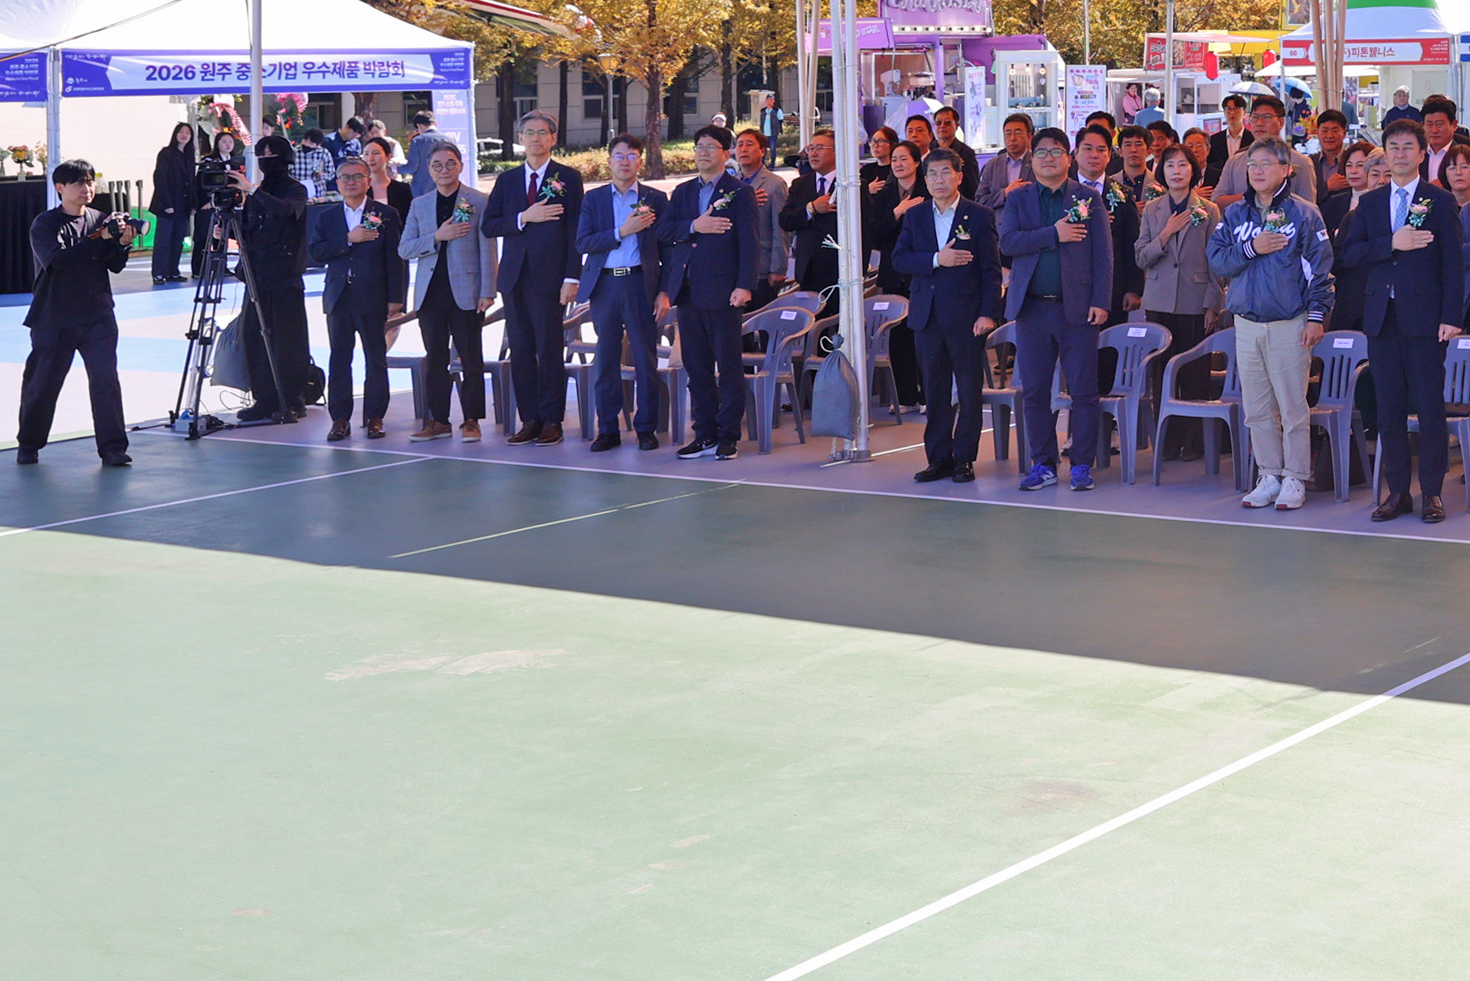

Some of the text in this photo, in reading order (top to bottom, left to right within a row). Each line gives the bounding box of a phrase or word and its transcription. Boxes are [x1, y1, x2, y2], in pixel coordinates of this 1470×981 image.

[145, 64, 196, 82] 2026
[200, 62, 232, 81] 원주
[301, 61, 361, 80] 우수제품
[363, 60, 406, 79] 박람회
